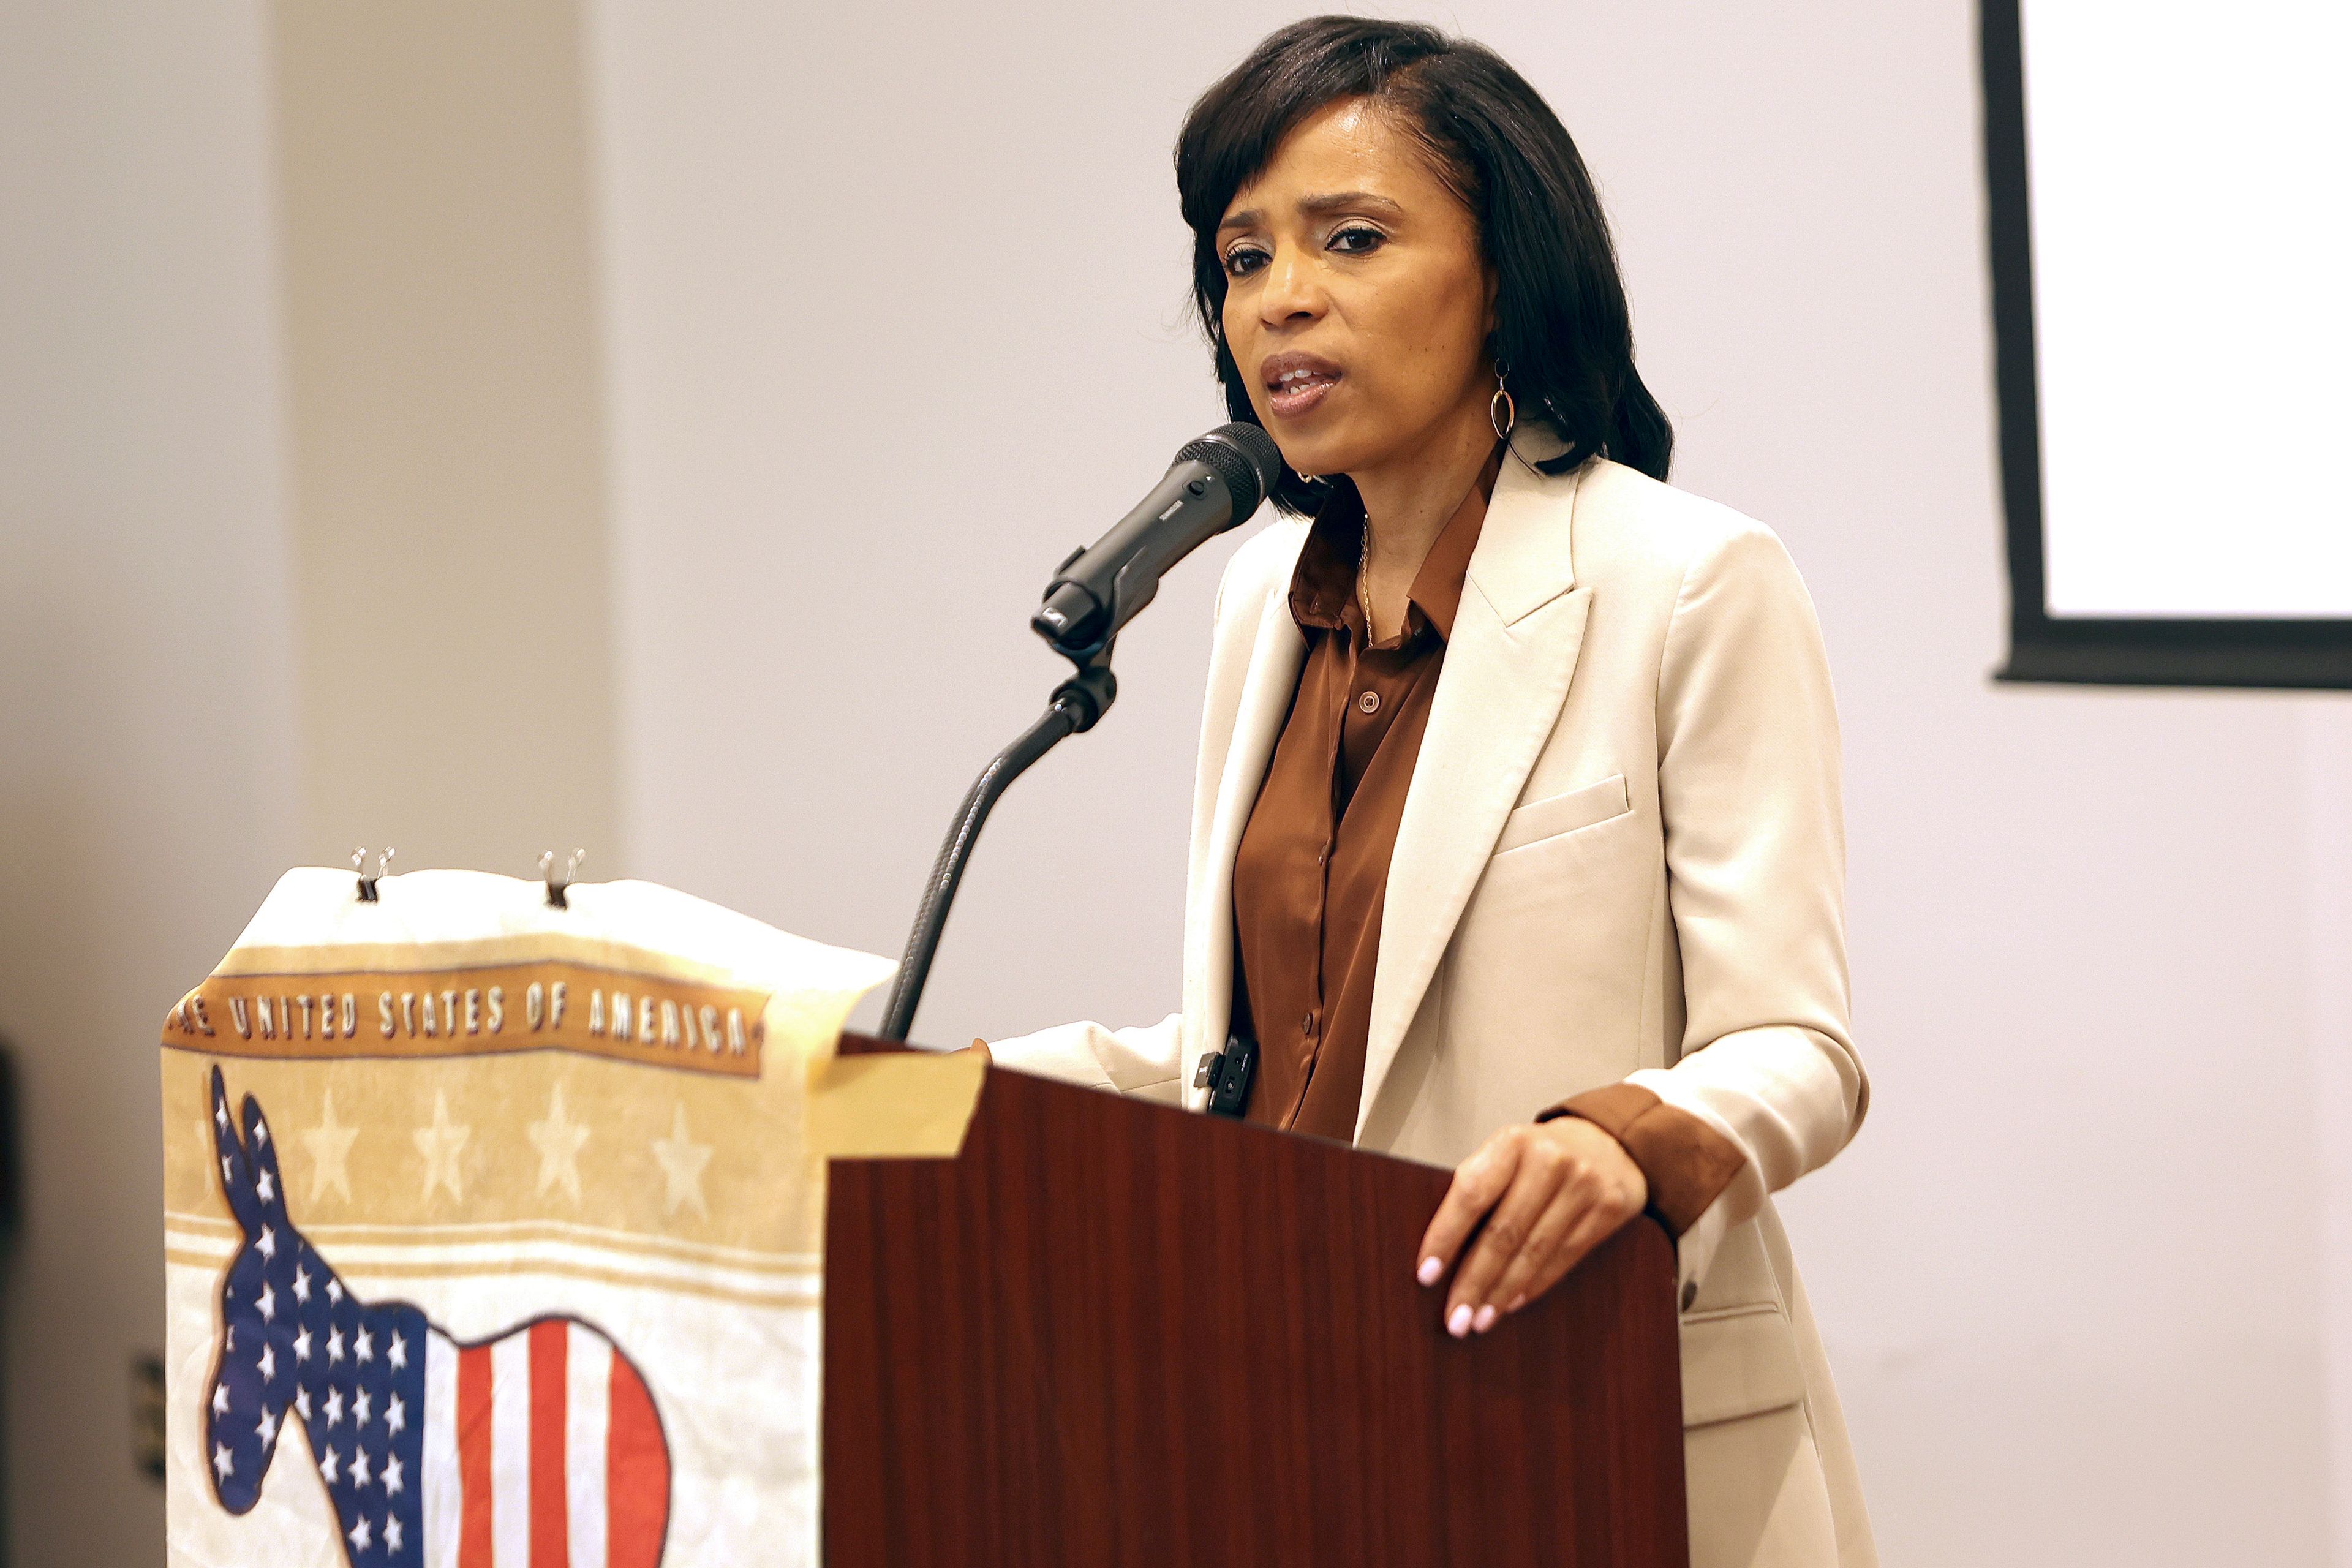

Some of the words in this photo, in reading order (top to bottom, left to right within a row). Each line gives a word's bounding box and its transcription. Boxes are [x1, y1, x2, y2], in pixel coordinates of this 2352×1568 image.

[228, 993, 356, 1040] UNITED
[378, 986, 504, 1039] STATES
[526, 981, 567, 1032] OF
[589, 988, 745, 1057] AMERICA
